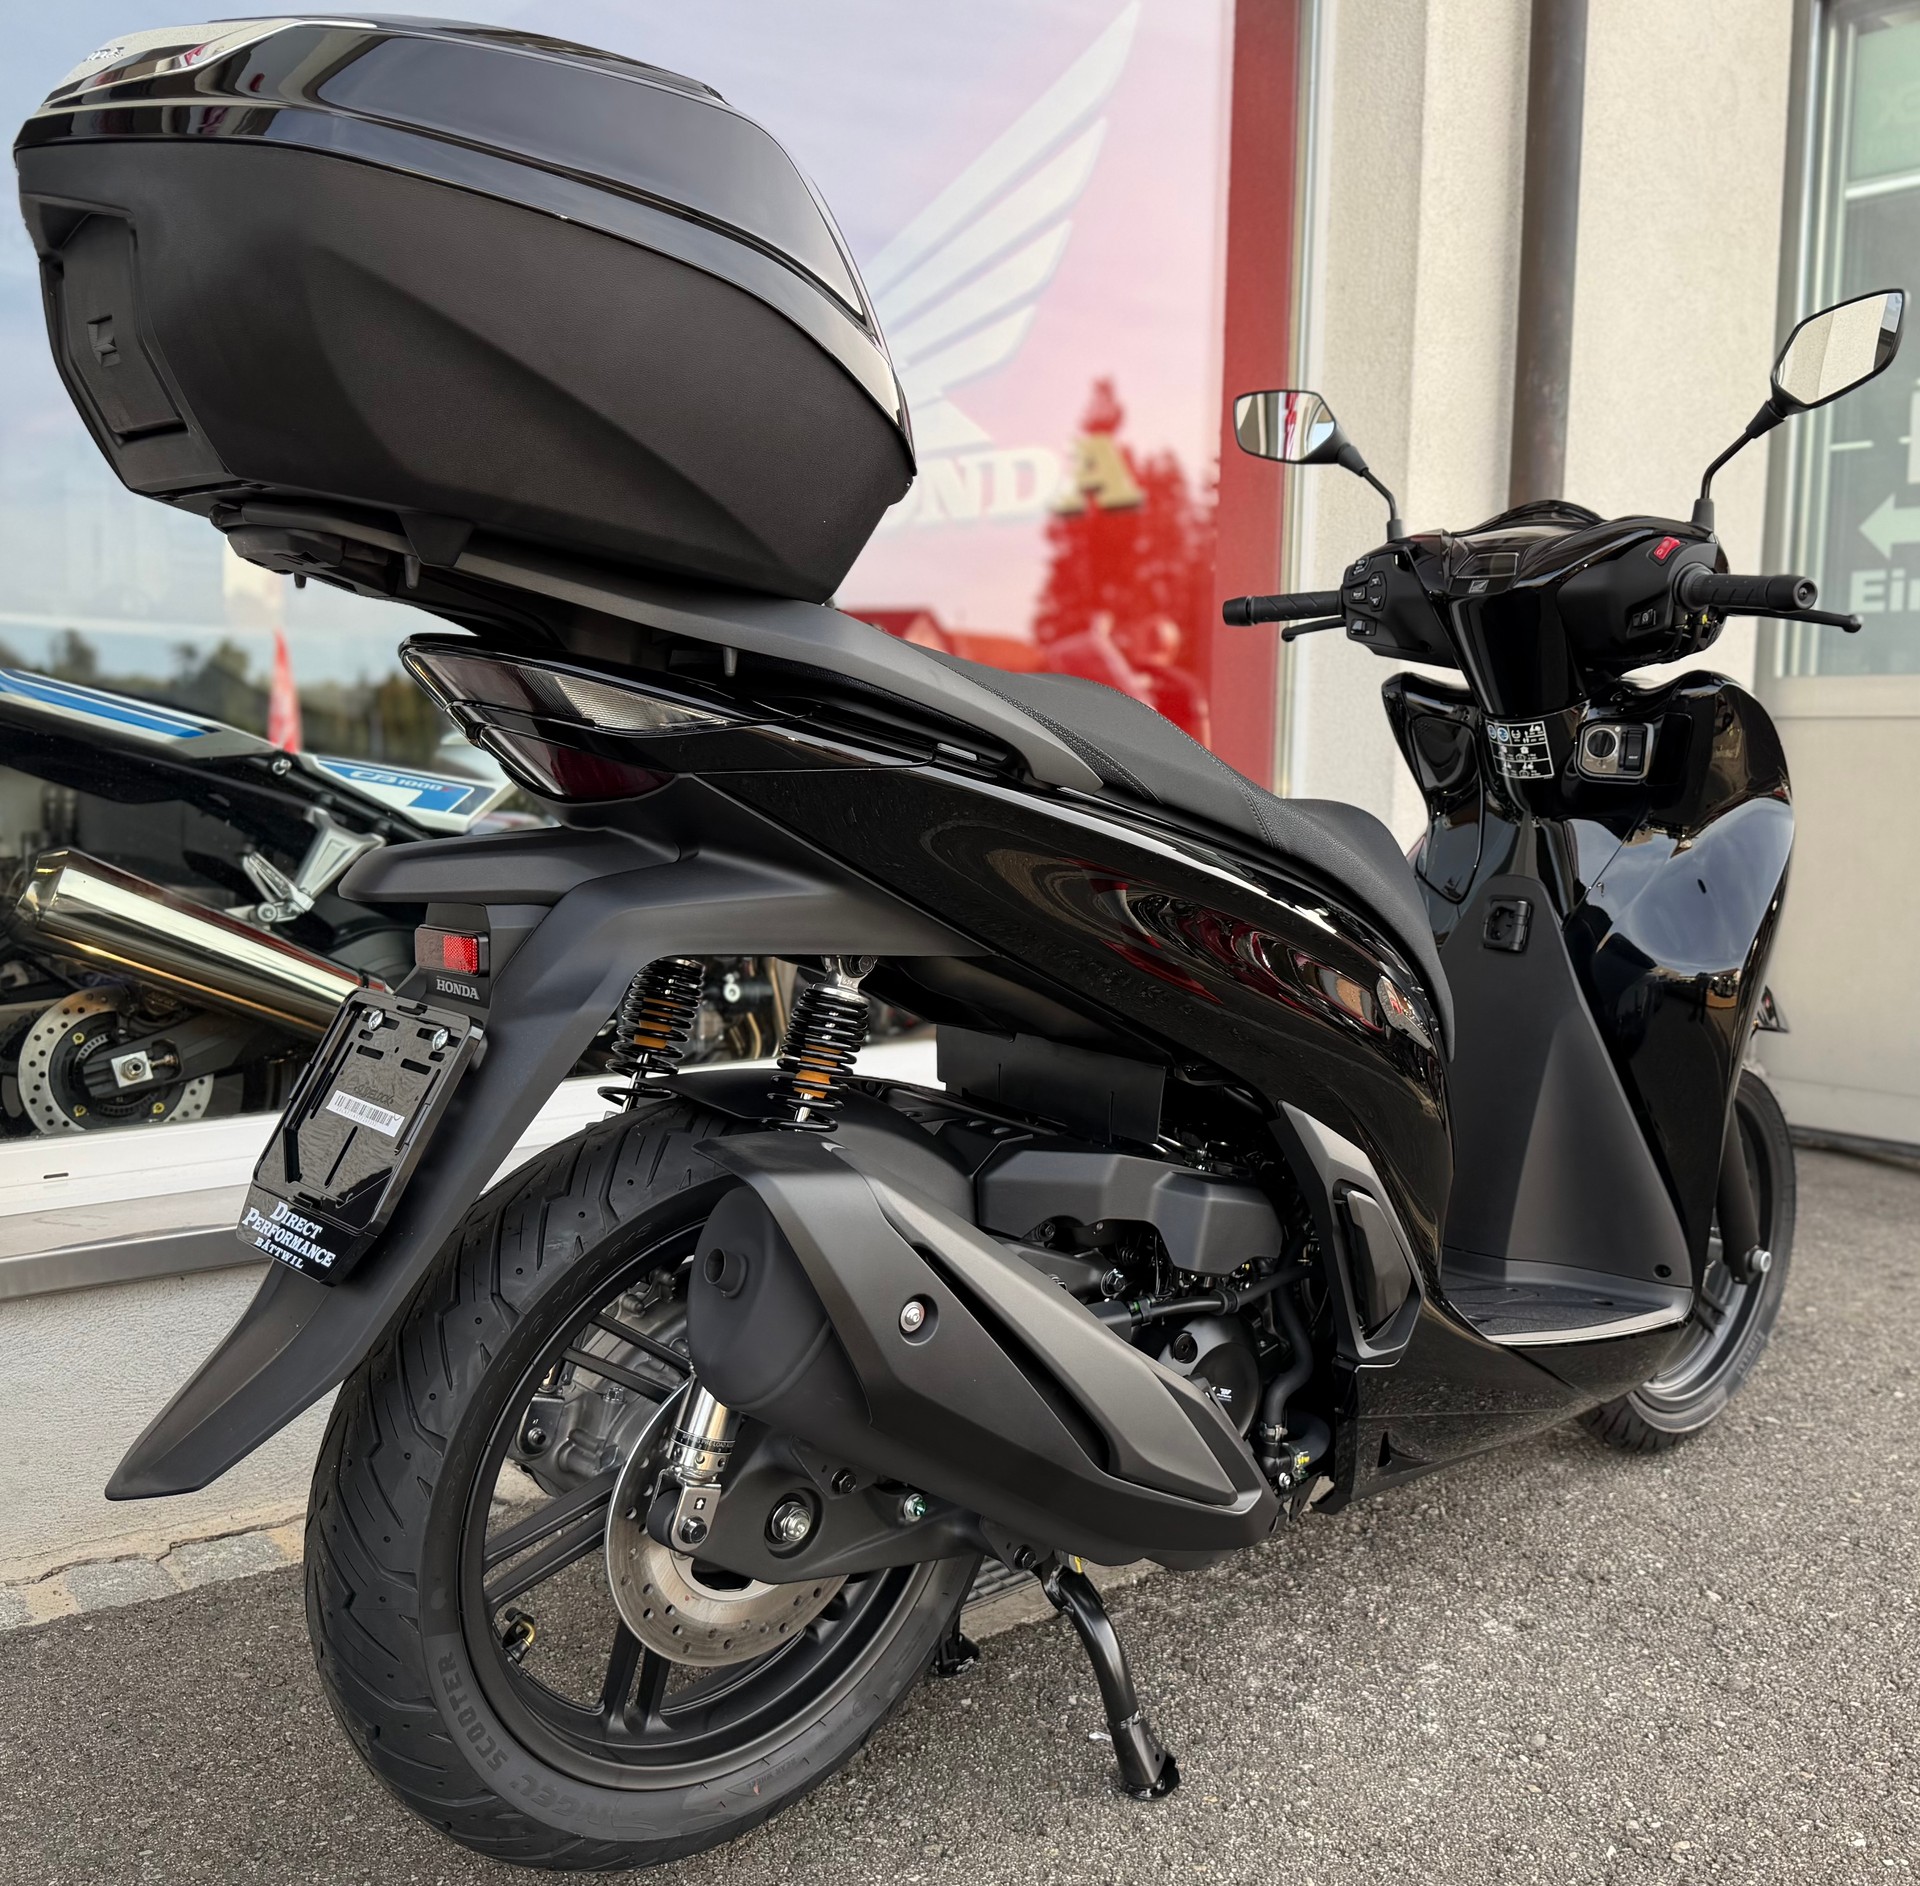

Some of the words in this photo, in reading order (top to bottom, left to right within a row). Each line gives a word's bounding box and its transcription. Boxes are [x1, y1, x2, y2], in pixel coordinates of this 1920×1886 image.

[880, 434, 1144, 528] NDA
[436, 978, 480, 1000] HONDA
[241, 1206, 337, 1268] PERFORMANCE
[269, 1201, 323, 1239] DIRECT
[437, 1651, 508, 1771] SCOOTER
